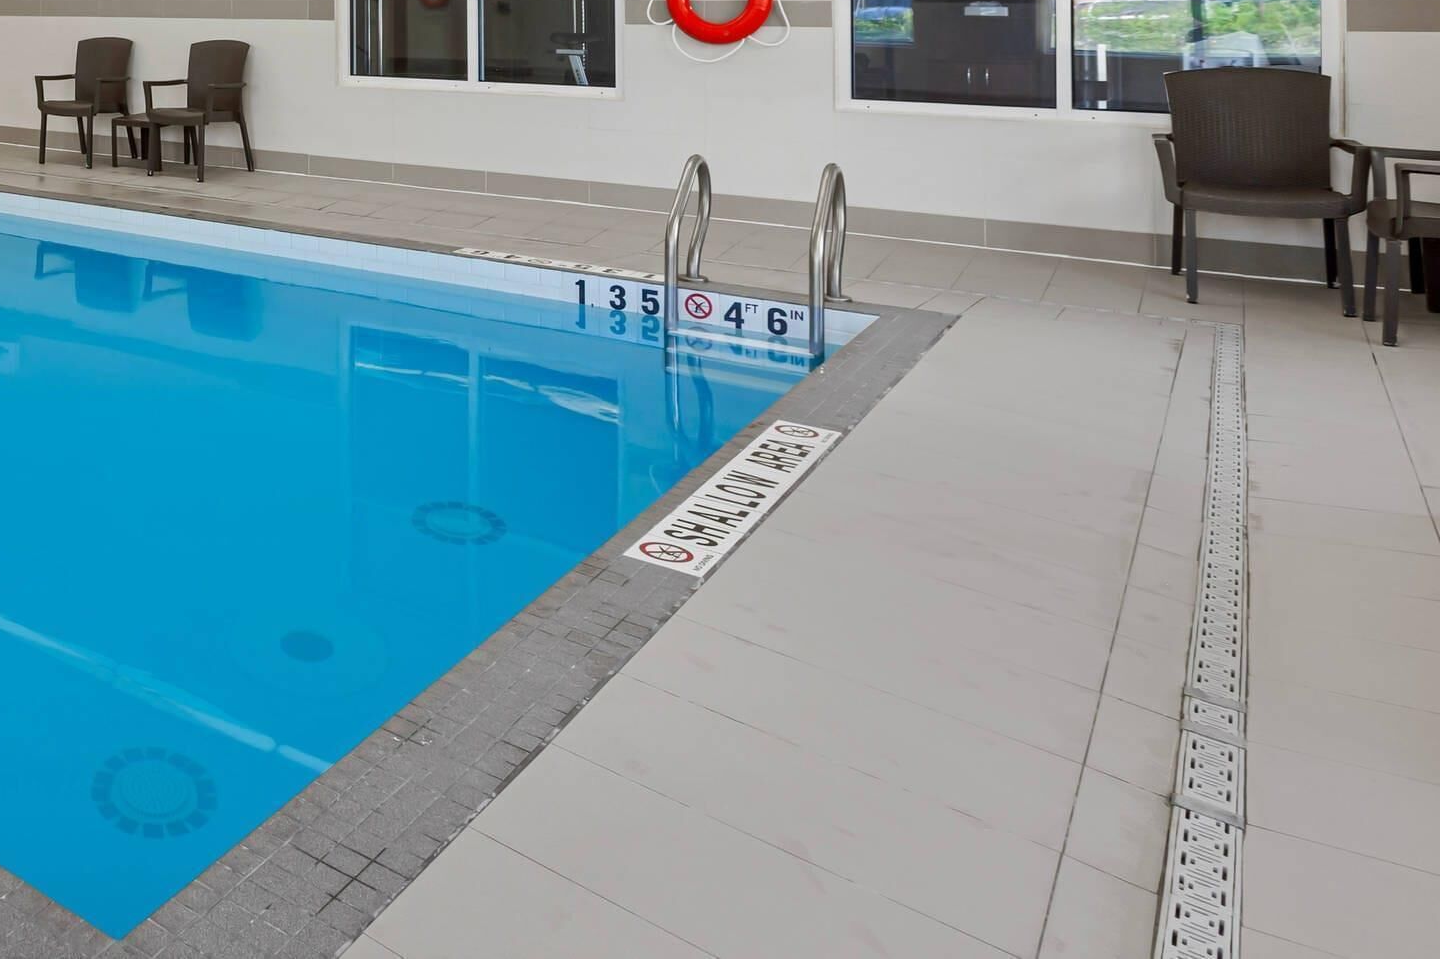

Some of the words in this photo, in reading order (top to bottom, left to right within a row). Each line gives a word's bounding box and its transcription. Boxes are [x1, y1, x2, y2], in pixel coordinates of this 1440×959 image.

[724, 302, 745, 329] 4
[745, 303, 759, 314] FT
[767, 308, 788, 335] 6
[790, 310, 804, 321] IN
[664, 470, 781, 547] SHALLOW
[745, 439, 816, 473] AREA
